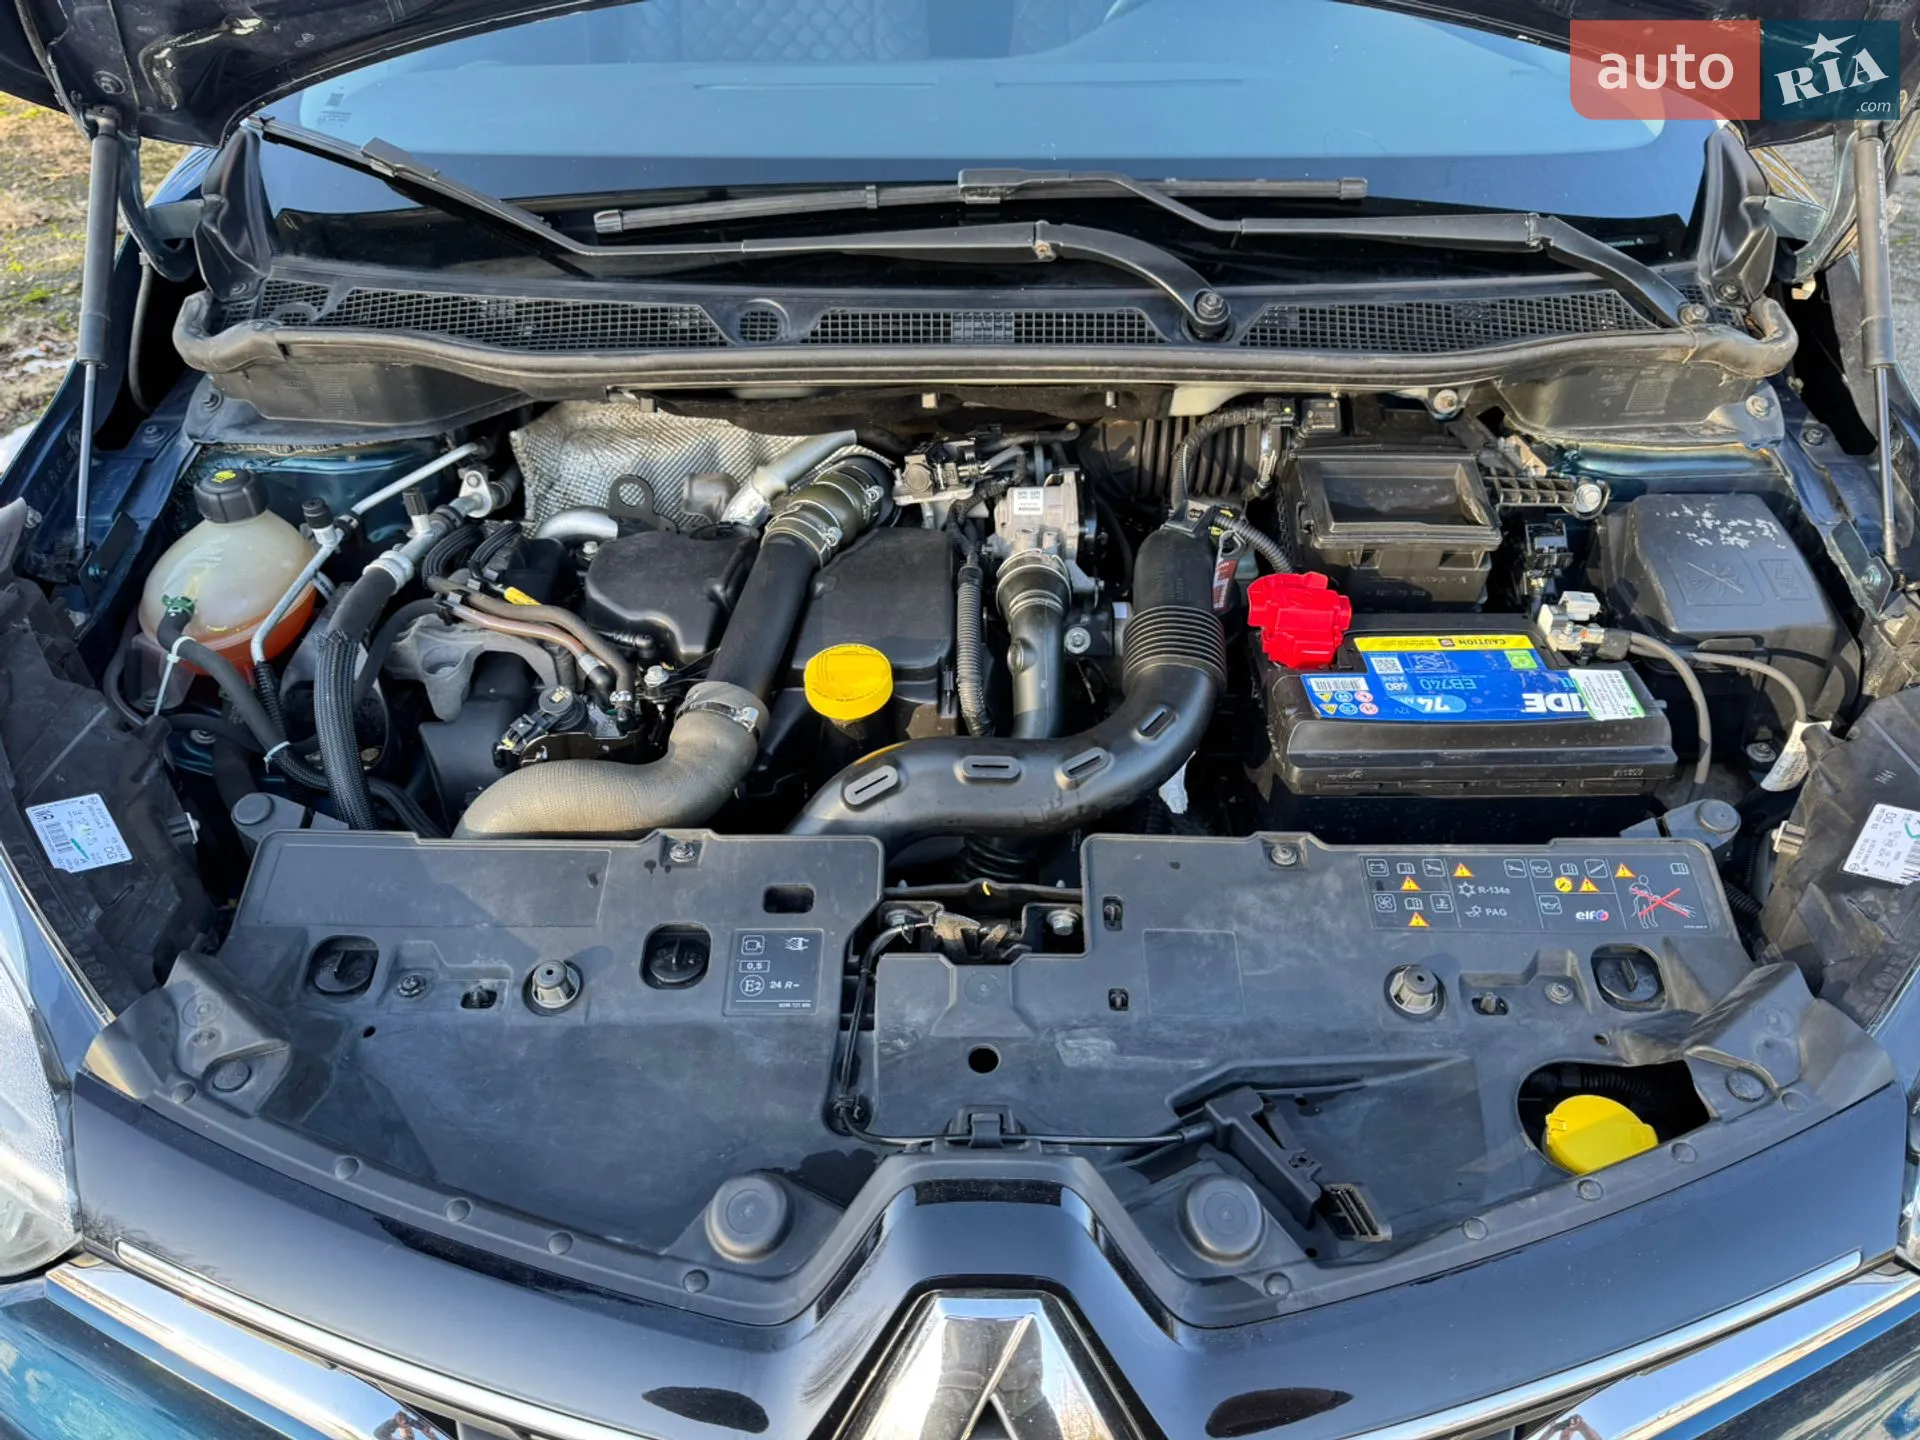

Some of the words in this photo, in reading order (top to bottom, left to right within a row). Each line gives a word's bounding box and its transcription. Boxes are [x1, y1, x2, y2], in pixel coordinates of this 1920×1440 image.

[1458, 638, 1507, 646] CAUTION
[1385, 682, 1408, 691] 680
[1419, 678, 1478, 690] EB740
[1416, 697, 1450, 713] 74
[1478, 886, 1511, 895] R-134a
[1485, 908, 1507, 917] PAG
[769, 980, 782, 990] 24
